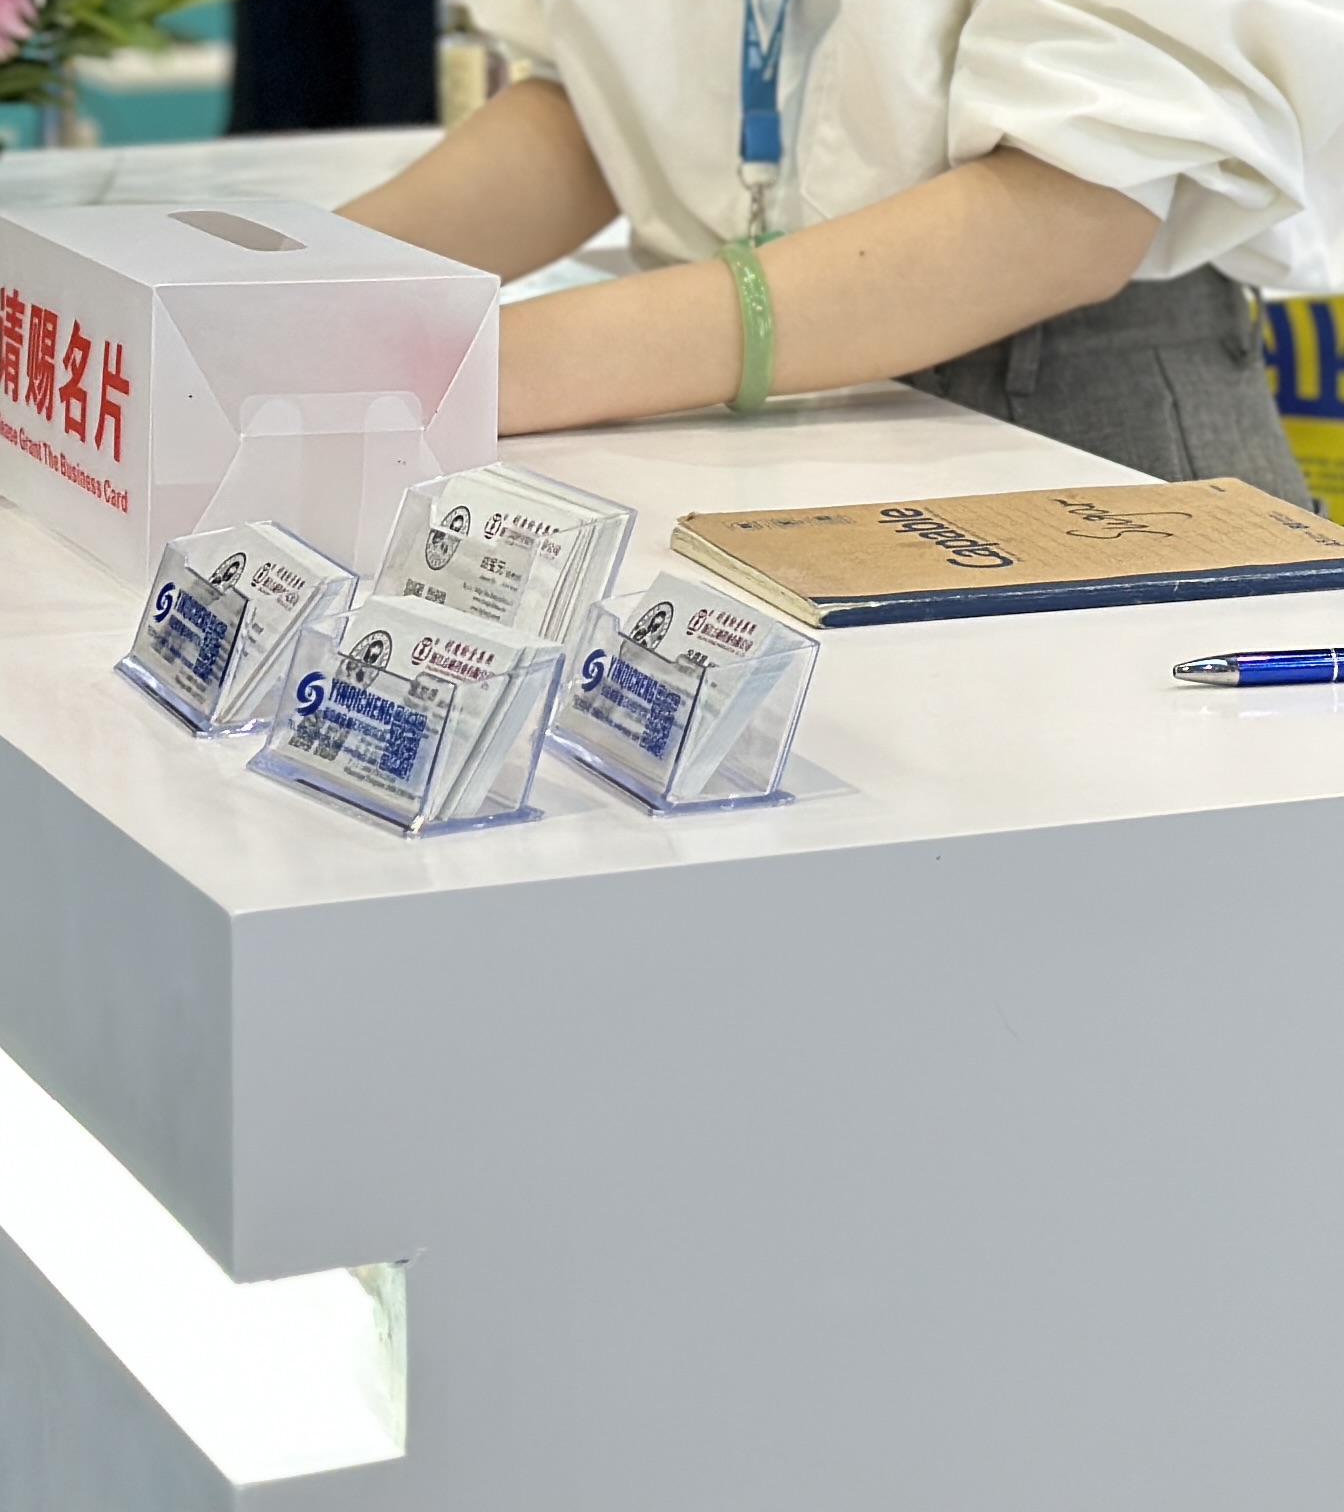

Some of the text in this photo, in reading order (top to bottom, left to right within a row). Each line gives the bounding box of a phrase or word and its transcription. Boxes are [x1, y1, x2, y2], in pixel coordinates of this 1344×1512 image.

[19, 427, 42, 463] Grant
[42, 441, 59, 473] The
[59, 452, 102, 500] Business
[103, 478, 129, 514] Card
[877, 506, 1015, 570] Capable
